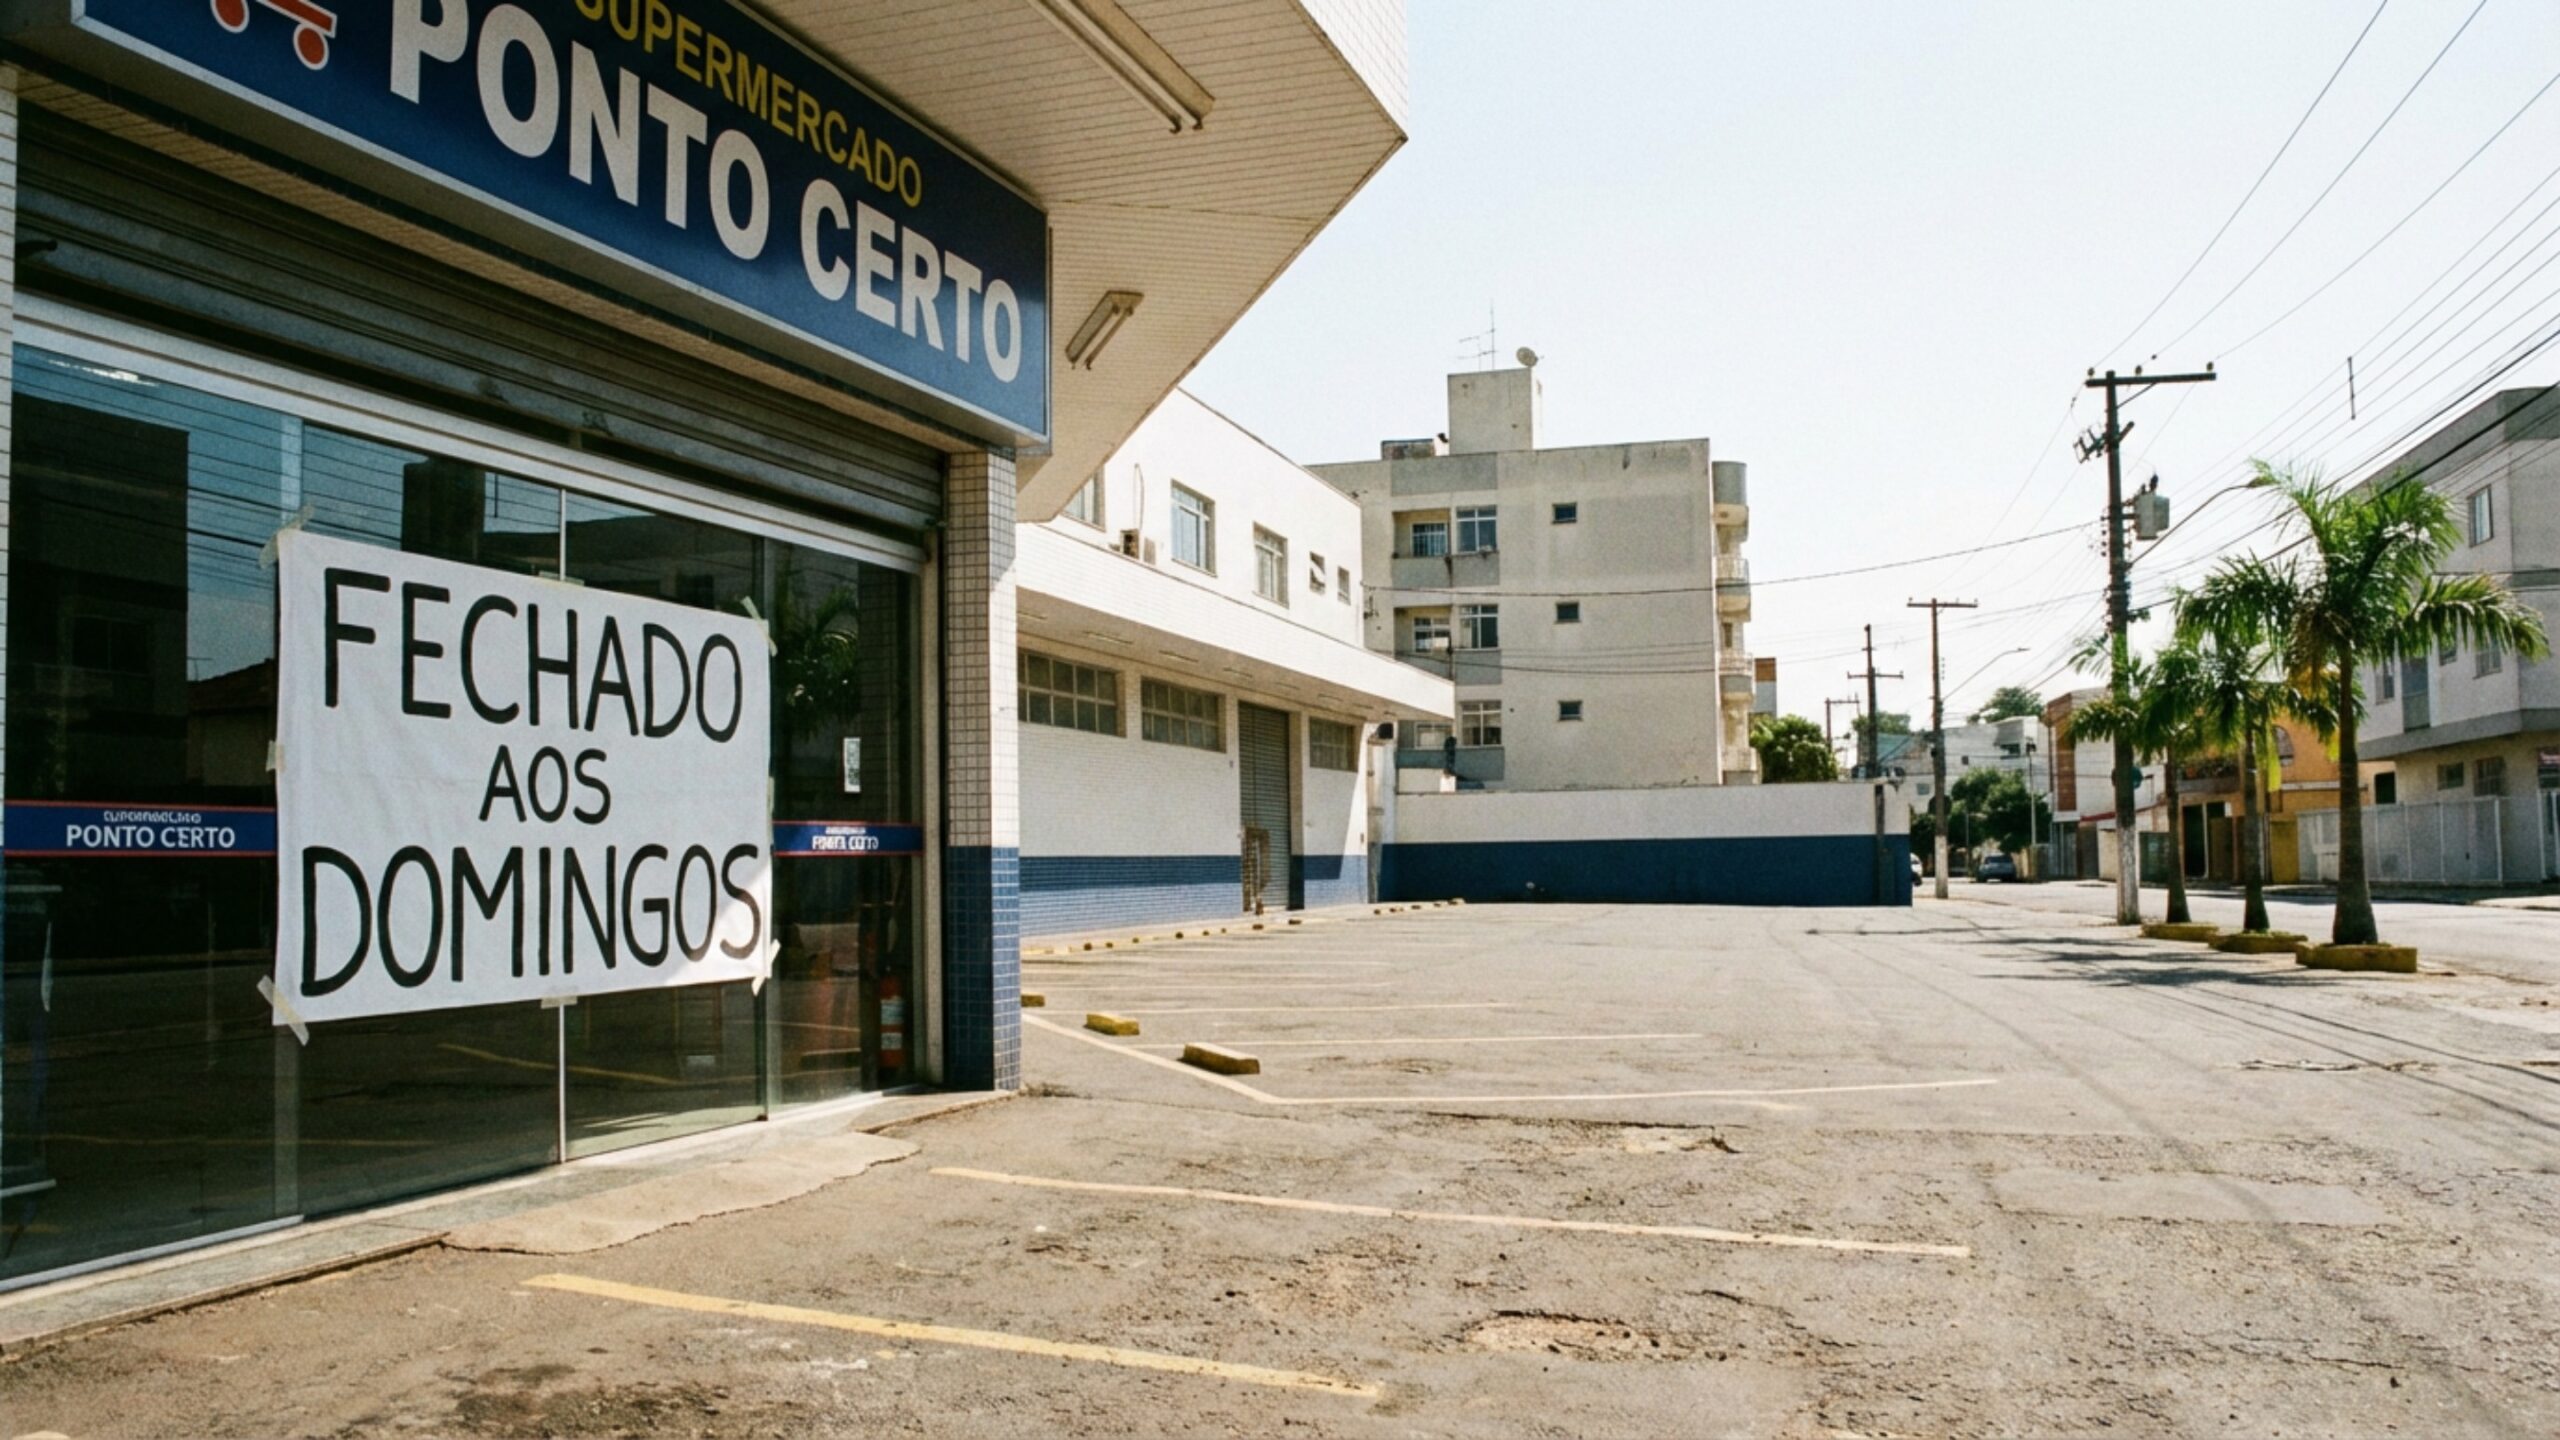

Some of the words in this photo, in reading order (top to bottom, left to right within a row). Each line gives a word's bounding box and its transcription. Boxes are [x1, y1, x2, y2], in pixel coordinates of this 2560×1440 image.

[390, 0, 770, 260] PONTO
[800, 178, 1022, 384] CERTO
[324, 567, 742, 743] FECHADO
[66, 824, 156, 849] PONTO
[160, 826, 236, 849] CERTO
[478, 744, 611, 825] AOS
[300, 843, 762, 998] DOMINGOS
